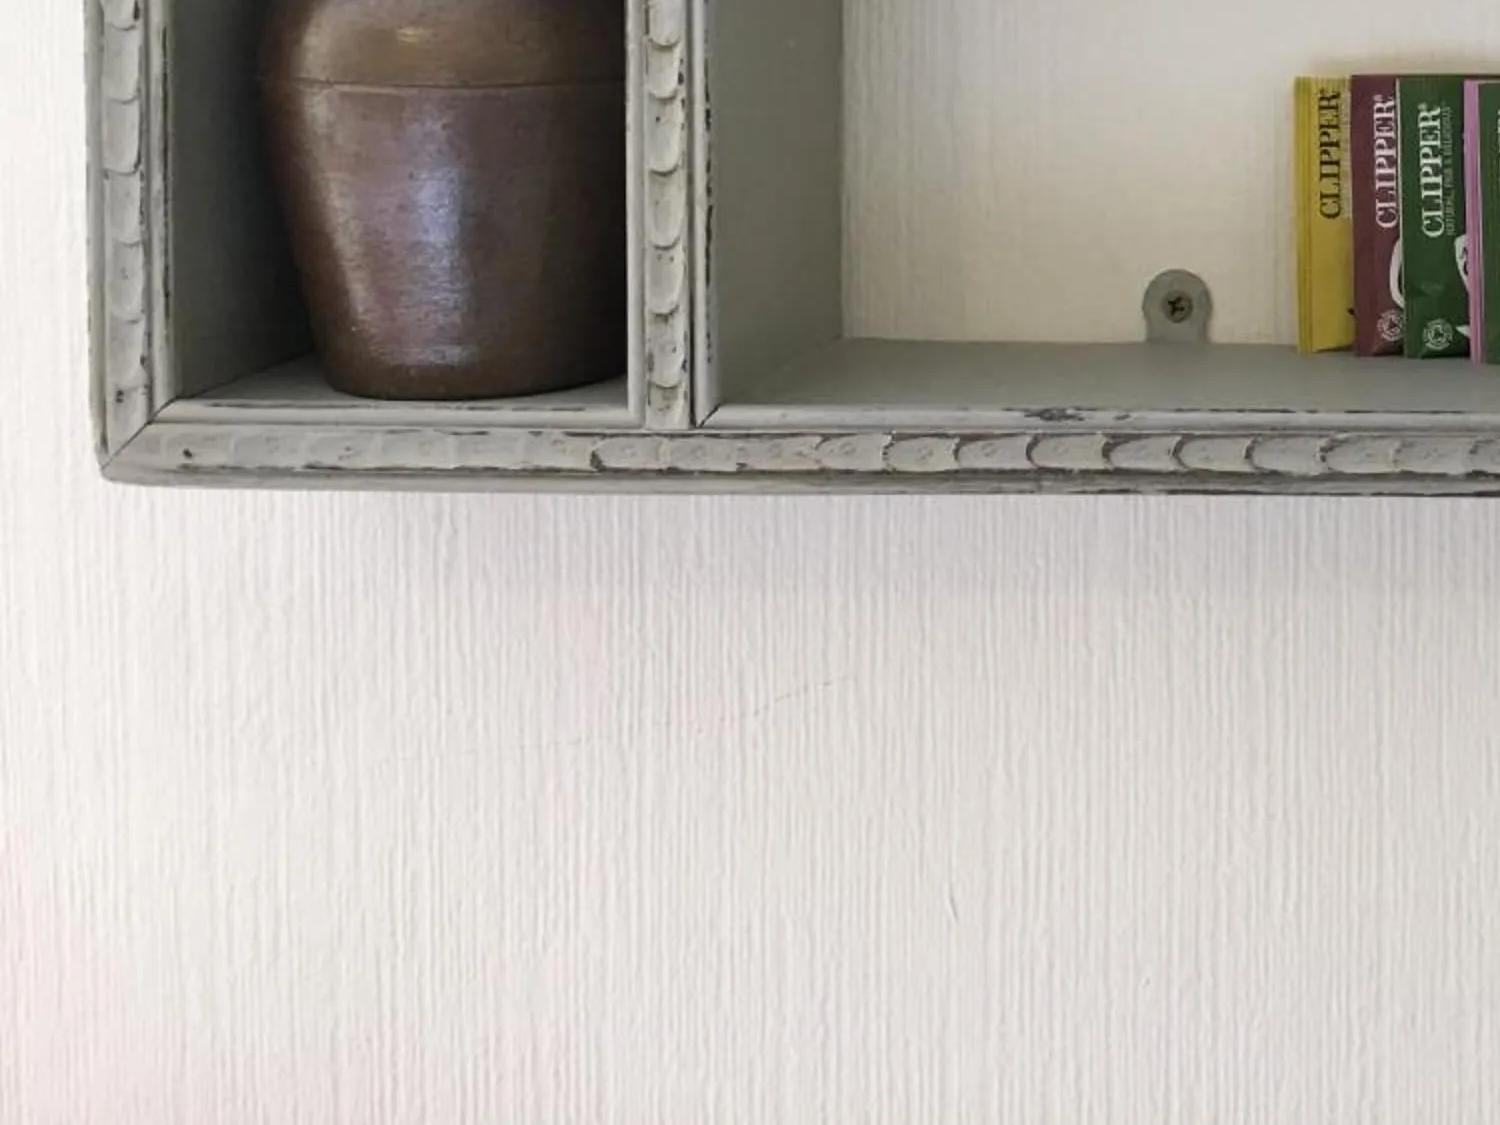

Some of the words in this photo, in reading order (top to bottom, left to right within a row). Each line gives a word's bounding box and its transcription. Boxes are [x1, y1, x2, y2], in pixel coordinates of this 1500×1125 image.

[1318, 89, 1342, 220] CLIPPER
[1373, 99, 1399, 229] CLIPPER
[1419, 105, 1446, 238] CLIPPER
